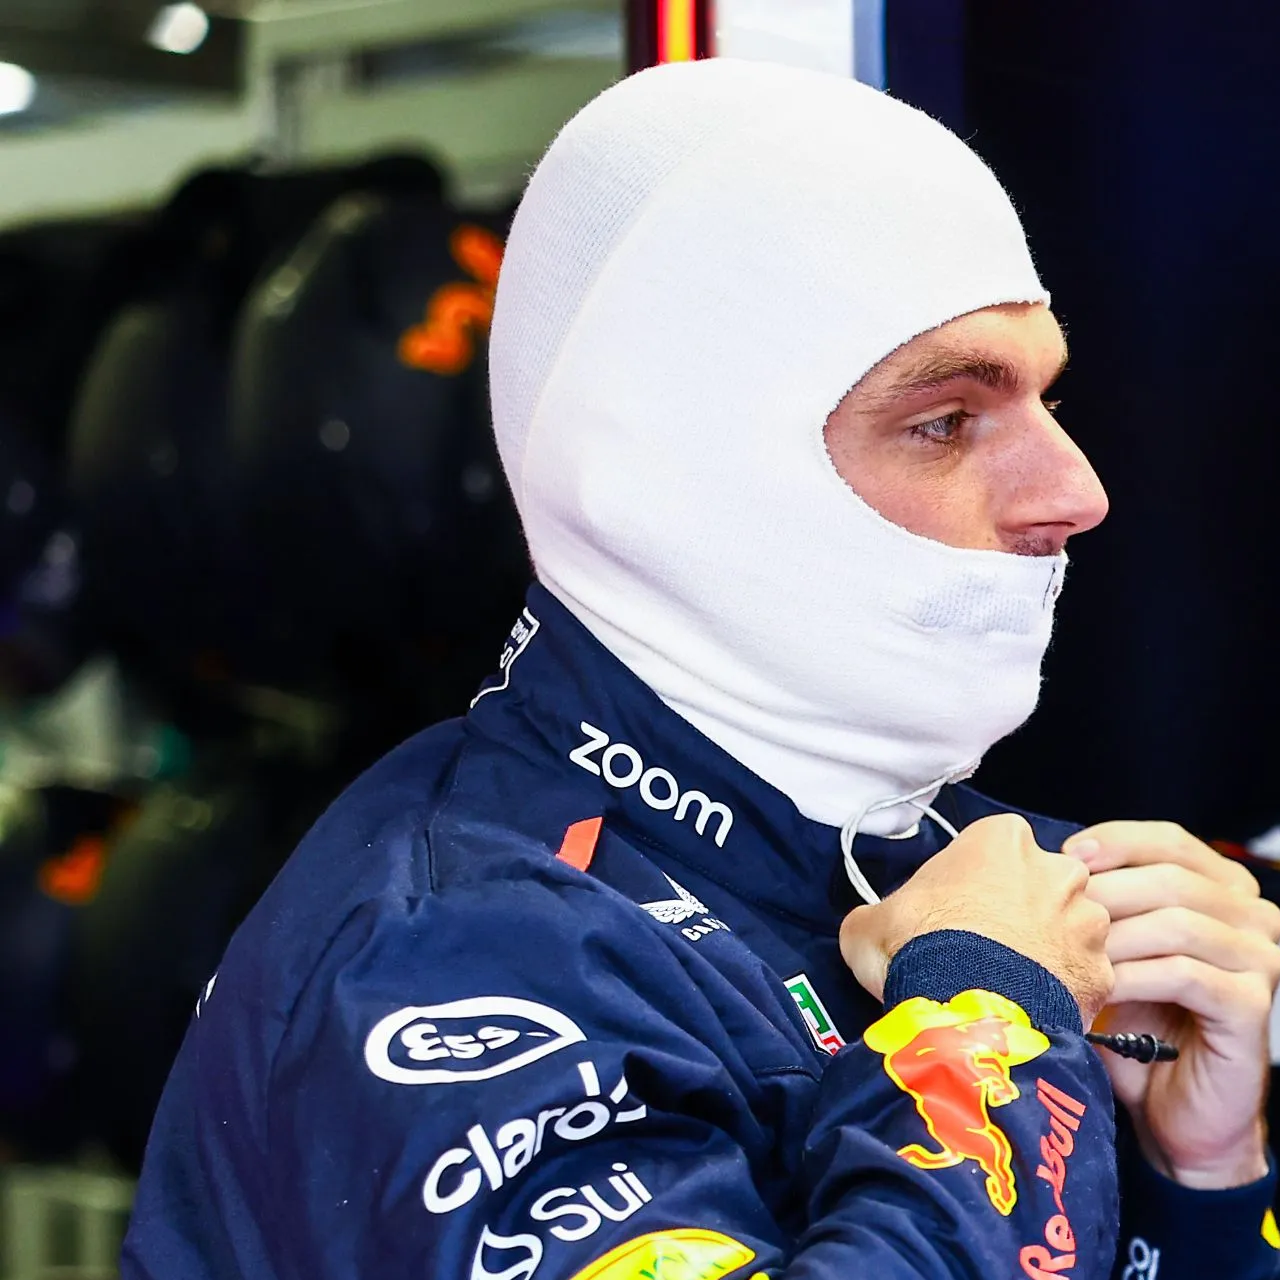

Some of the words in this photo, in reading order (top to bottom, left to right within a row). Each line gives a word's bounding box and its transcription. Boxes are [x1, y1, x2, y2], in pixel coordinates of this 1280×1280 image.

[569, 721, 735, 848] zoom
[401, 1023, 550, 1062] Ess
[422, 1098, 612, 1214] Claro
[530, 1162, 653, 1241] Sui
